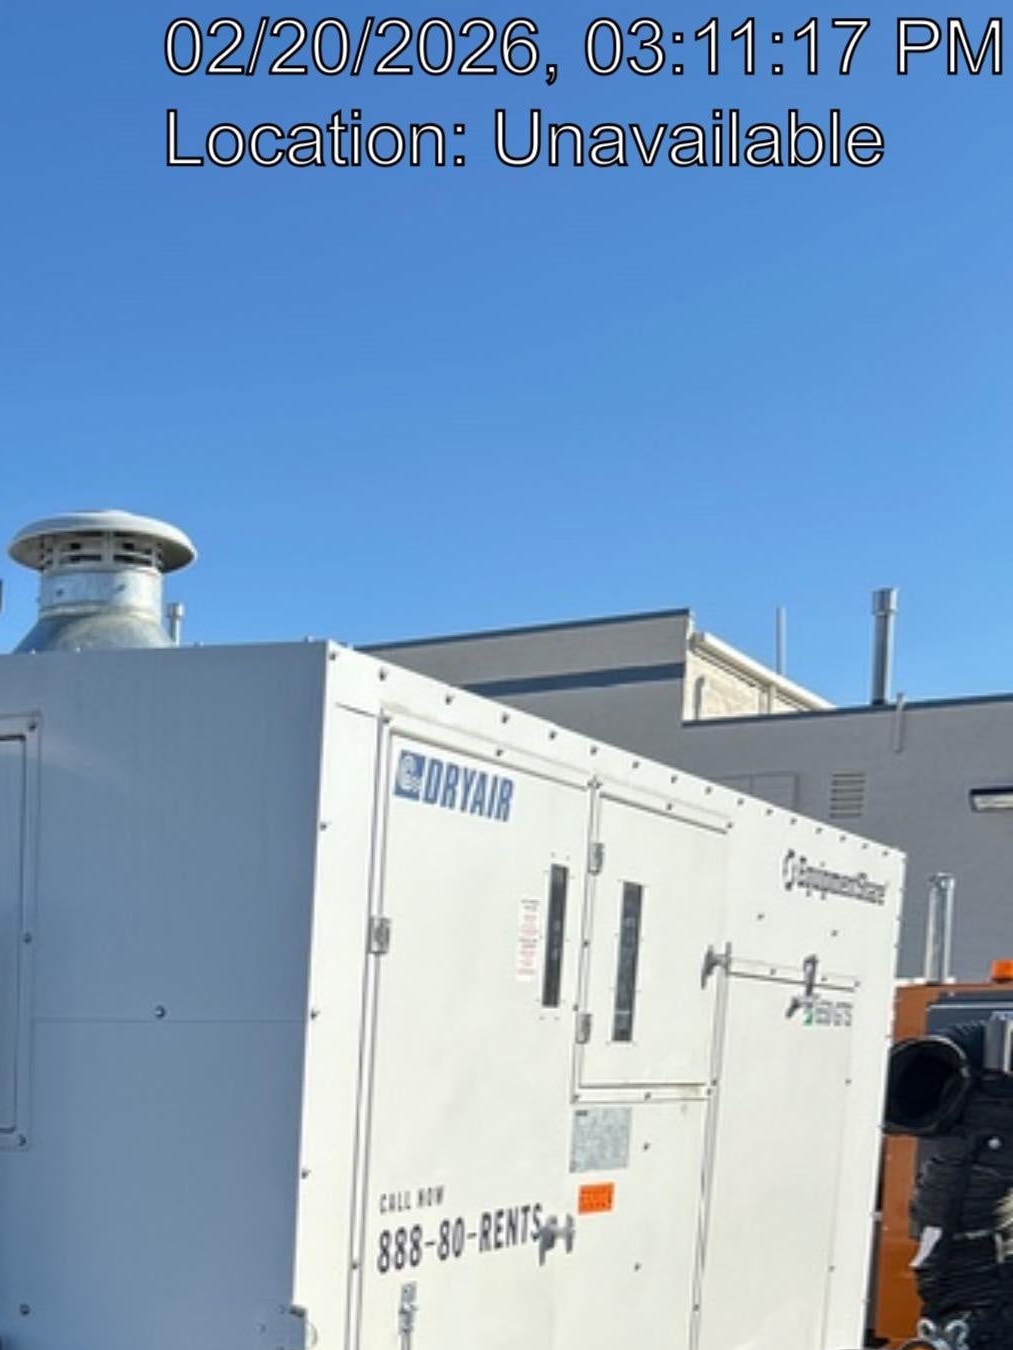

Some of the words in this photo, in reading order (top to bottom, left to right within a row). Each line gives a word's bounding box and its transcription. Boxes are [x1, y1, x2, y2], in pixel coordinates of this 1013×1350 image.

[422, 757, 515, 823] DRYAIR
[380, 1190, 412, 1215] CALL
[417, 1185, 445, 1208] NOW
[377, 1202, 544, 1274] 888-80-RENTS
